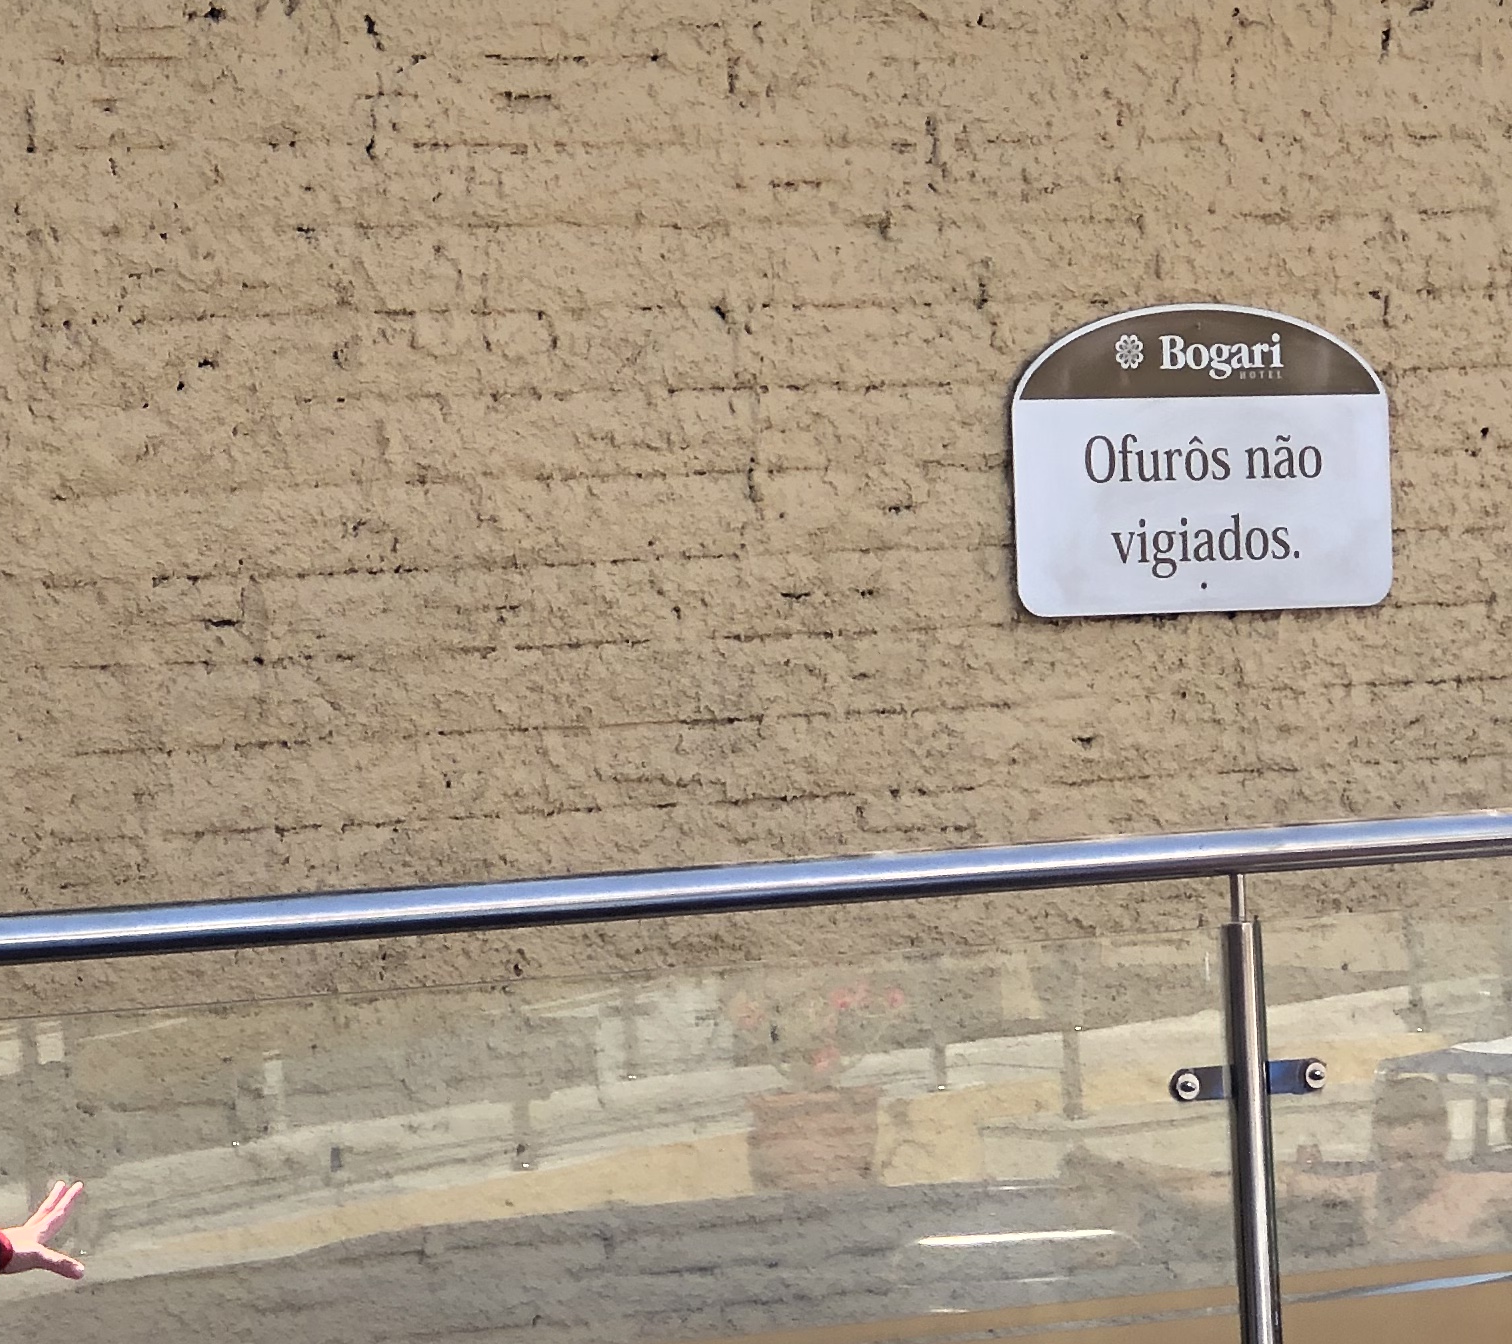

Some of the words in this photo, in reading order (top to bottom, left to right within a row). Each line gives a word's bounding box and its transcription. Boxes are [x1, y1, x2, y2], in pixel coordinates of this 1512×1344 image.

[1159, 332, 1285, 380] Bogari
[1240, 370, 1284, 380] HOTEL
[1085, 433, 1232, 484] Ofurôs
[1245, 434, 1323, 480] não
[1111, 513, 1301, 579] vigiados.
